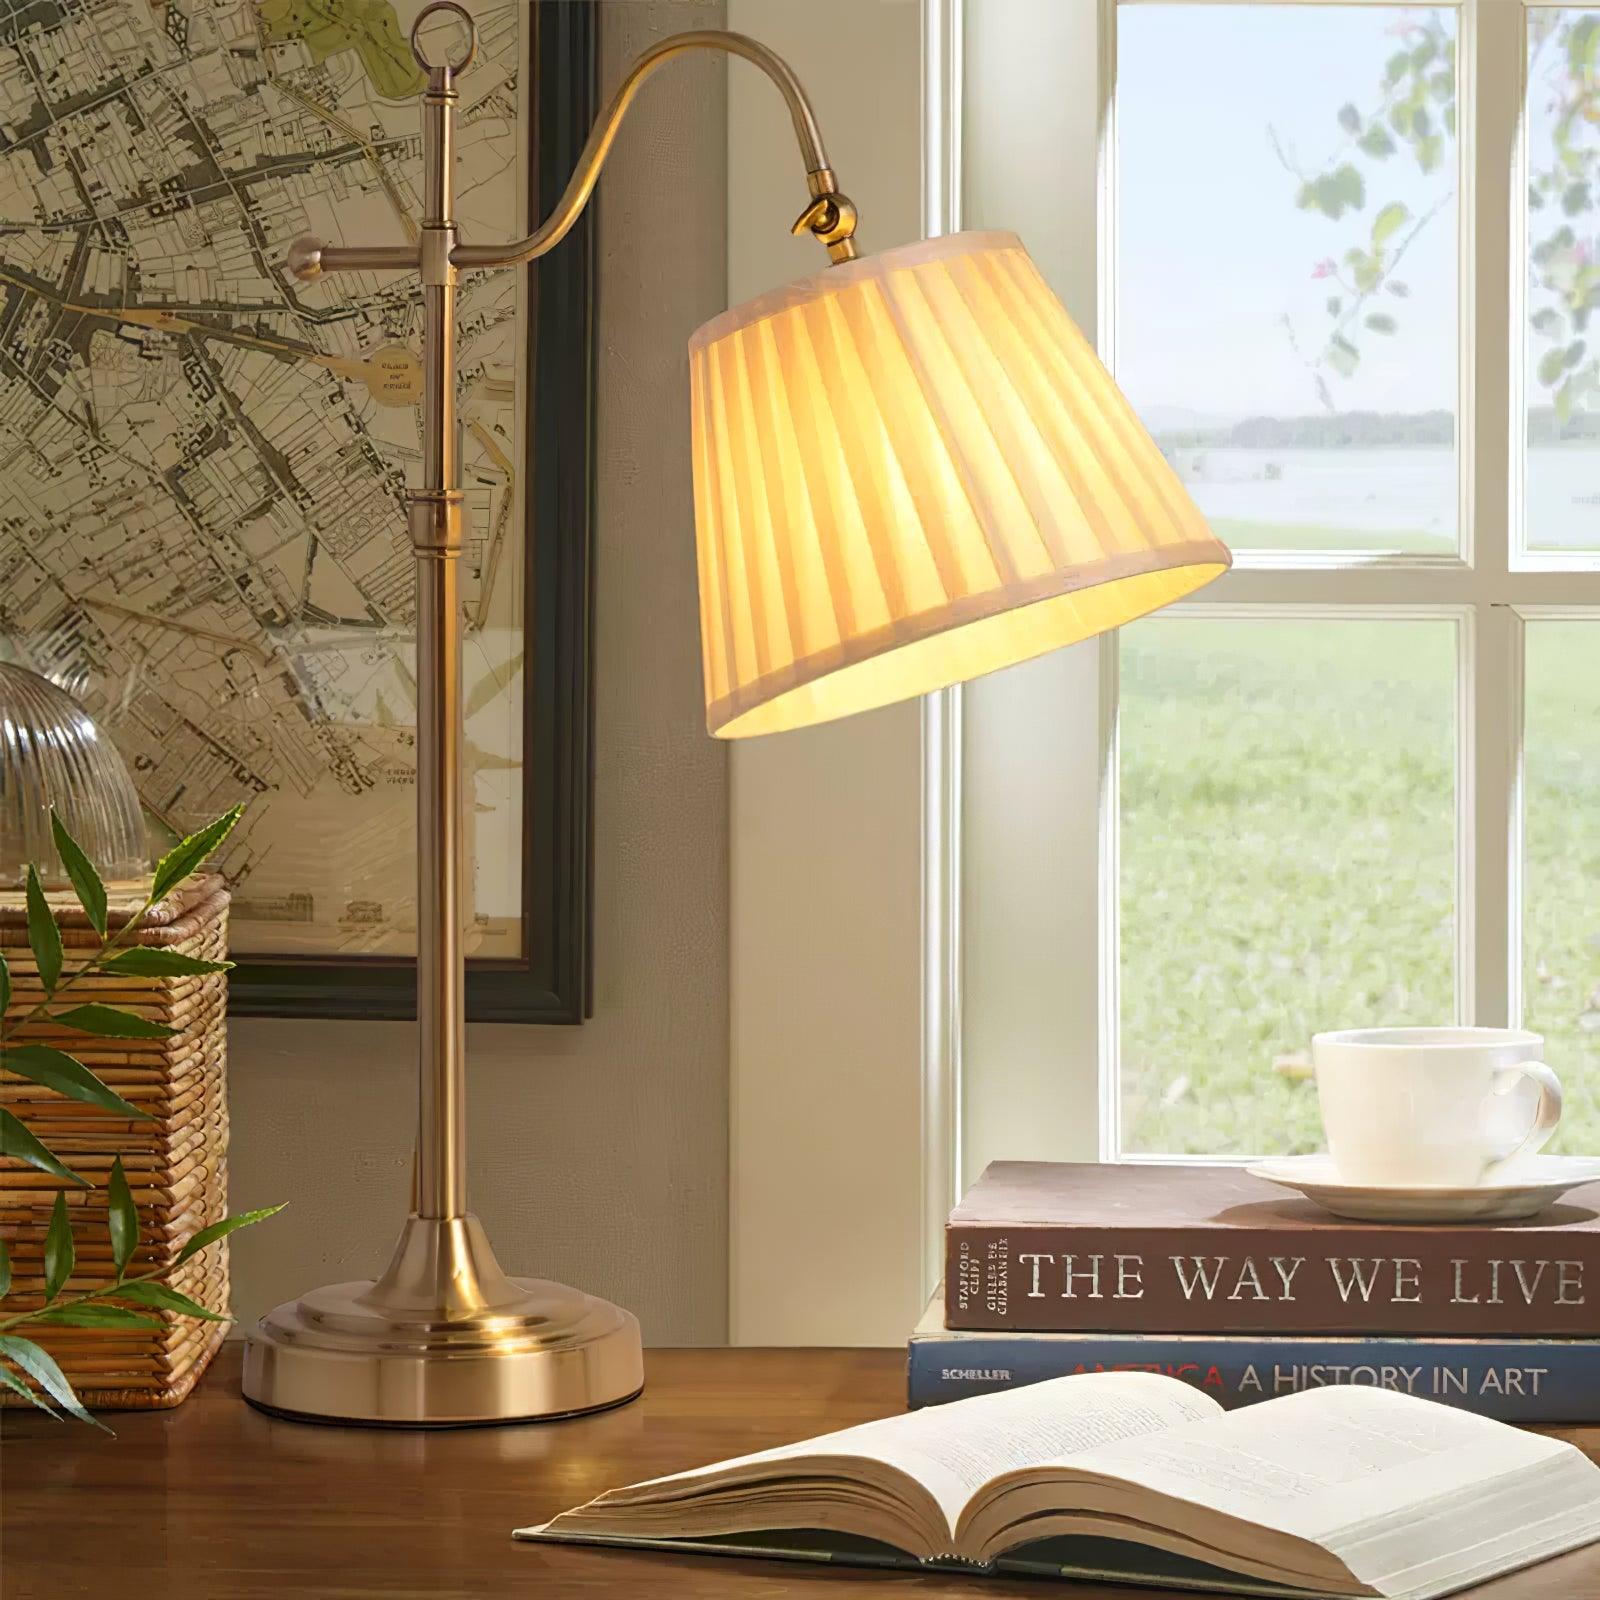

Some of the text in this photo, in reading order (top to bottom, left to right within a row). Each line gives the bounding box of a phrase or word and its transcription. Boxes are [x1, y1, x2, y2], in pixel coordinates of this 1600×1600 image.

[1019, 1254, 1586, 1304] THE WAY WE LIVE
[1239, 1364, 1262, 1392] A
[1274, 1364, 1423, 1393] HISTORY
[1433, 1366, 1468, 1394] IN
[1479, 1368, 1547, 1395] ART
